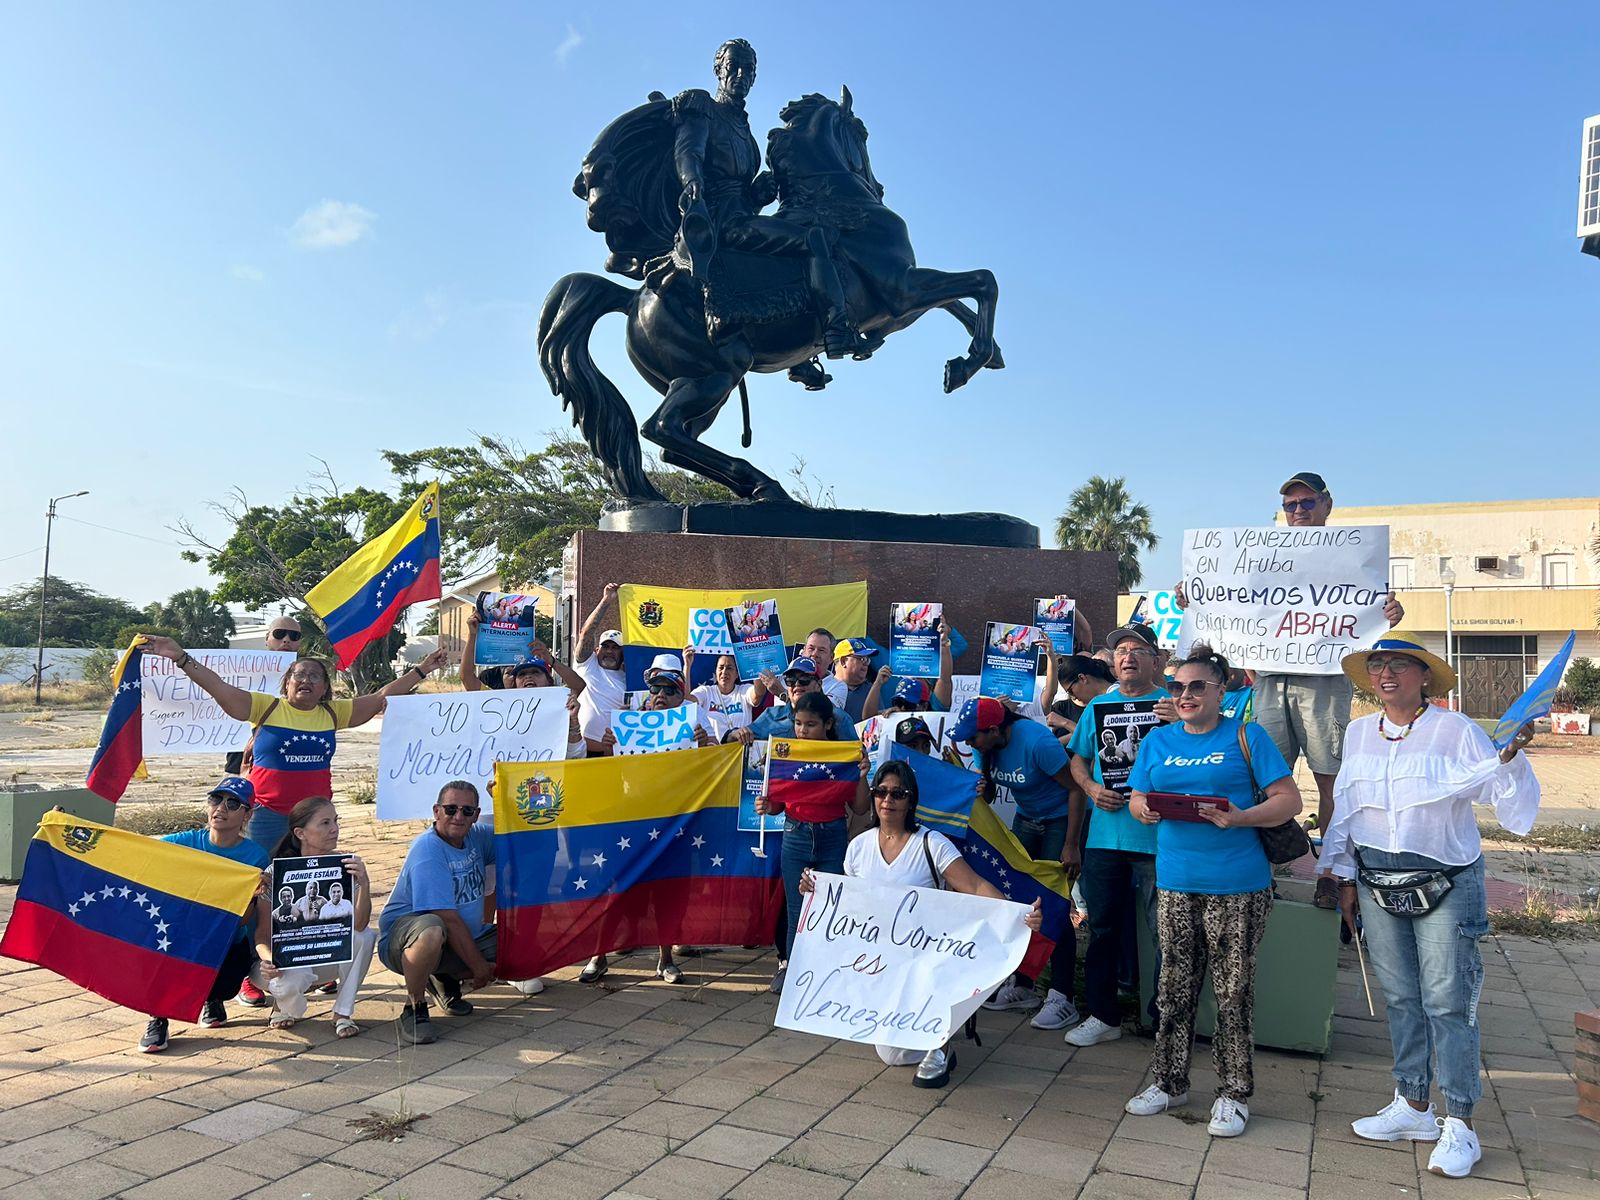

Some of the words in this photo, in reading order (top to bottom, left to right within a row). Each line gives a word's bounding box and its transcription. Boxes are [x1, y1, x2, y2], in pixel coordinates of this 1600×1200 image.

[1232, 547, 1294, 575] Aruba
[1154, 591, 1184, 615] CO
[492, 621, 516, 630] ALERTA
[694, 608, 727, 628] CO
[1149, 617, 1182, 640] VZ
[480, 627, 529, 637] INTERNACIONAL
[690, 629, 732, 648] VZL
[745, 634, 767, 644] ALERTA
[736, 639, 780, 652] INTERNACIONAL
[142, 656, 176, 678] ERTA
[428, 700, 470, 737] YO
[479, 696, 542, 735] SOY
[618, 705, 688, 729] CON
[1106, 715, 1132, 725] ¿DÓNDE
[1132, 713, 1156, 723] ESTÁN?
[159, 723, 245, 749] DDHH
[612, 722, 697, 749] VZLA
[284, 754, 325, 763] VENEZUELA
[389, 738, 472, 785] María
[286, 871, 313, 882] ¿DÓNDE
[313, 868, 339, 879] ESTÁN?
[890, 889, 977, 960] Corina
[840, 953, 889, 976] es
